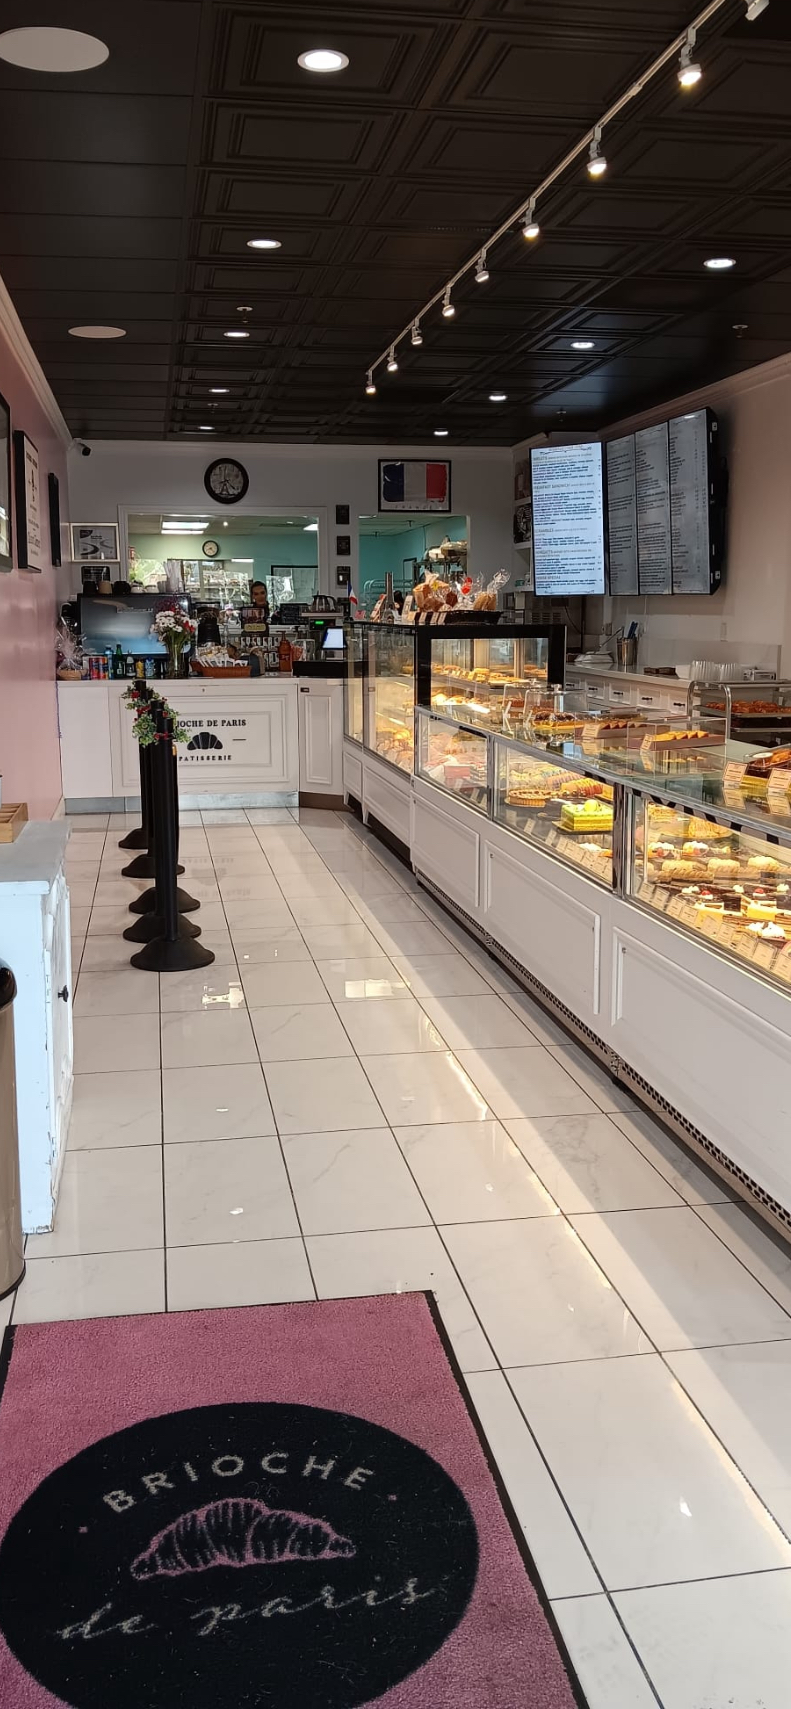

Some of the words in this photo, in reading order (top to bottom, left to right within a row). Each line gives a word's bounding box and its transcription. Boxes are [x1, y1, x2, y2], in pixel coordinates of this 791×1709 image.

[177, 720, 204, 728] IOCHE
[221, 719, 246, 727] PARIS
[102, 1451, 374, 1513] BRIOCHE
[56, 1601, 154, 1639] de
[191, 1576, 438, 1635] paris
